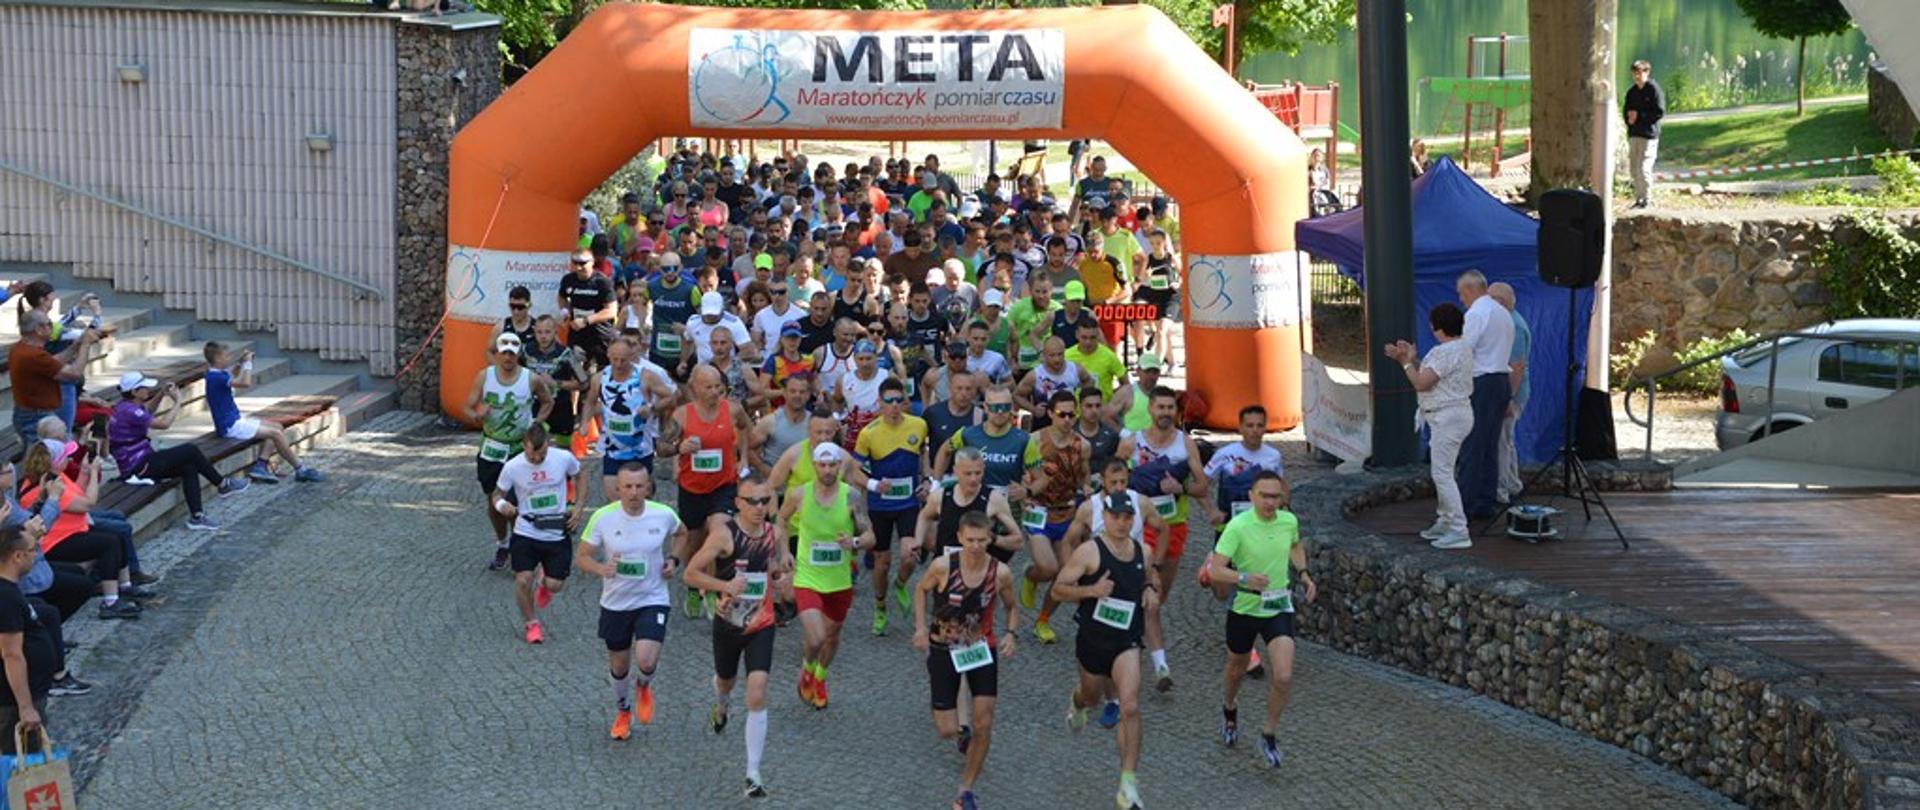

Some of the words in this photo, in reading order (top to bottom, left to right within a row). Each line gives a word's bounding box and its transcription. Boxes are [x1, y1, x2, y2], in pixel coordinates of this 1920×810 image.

[812, 34, 1045, 83] META
[797, 87, 926, 109] Maratończyk
[1094, 305, 1157, 320] 000000
[531, 471, 546, 481] 23
